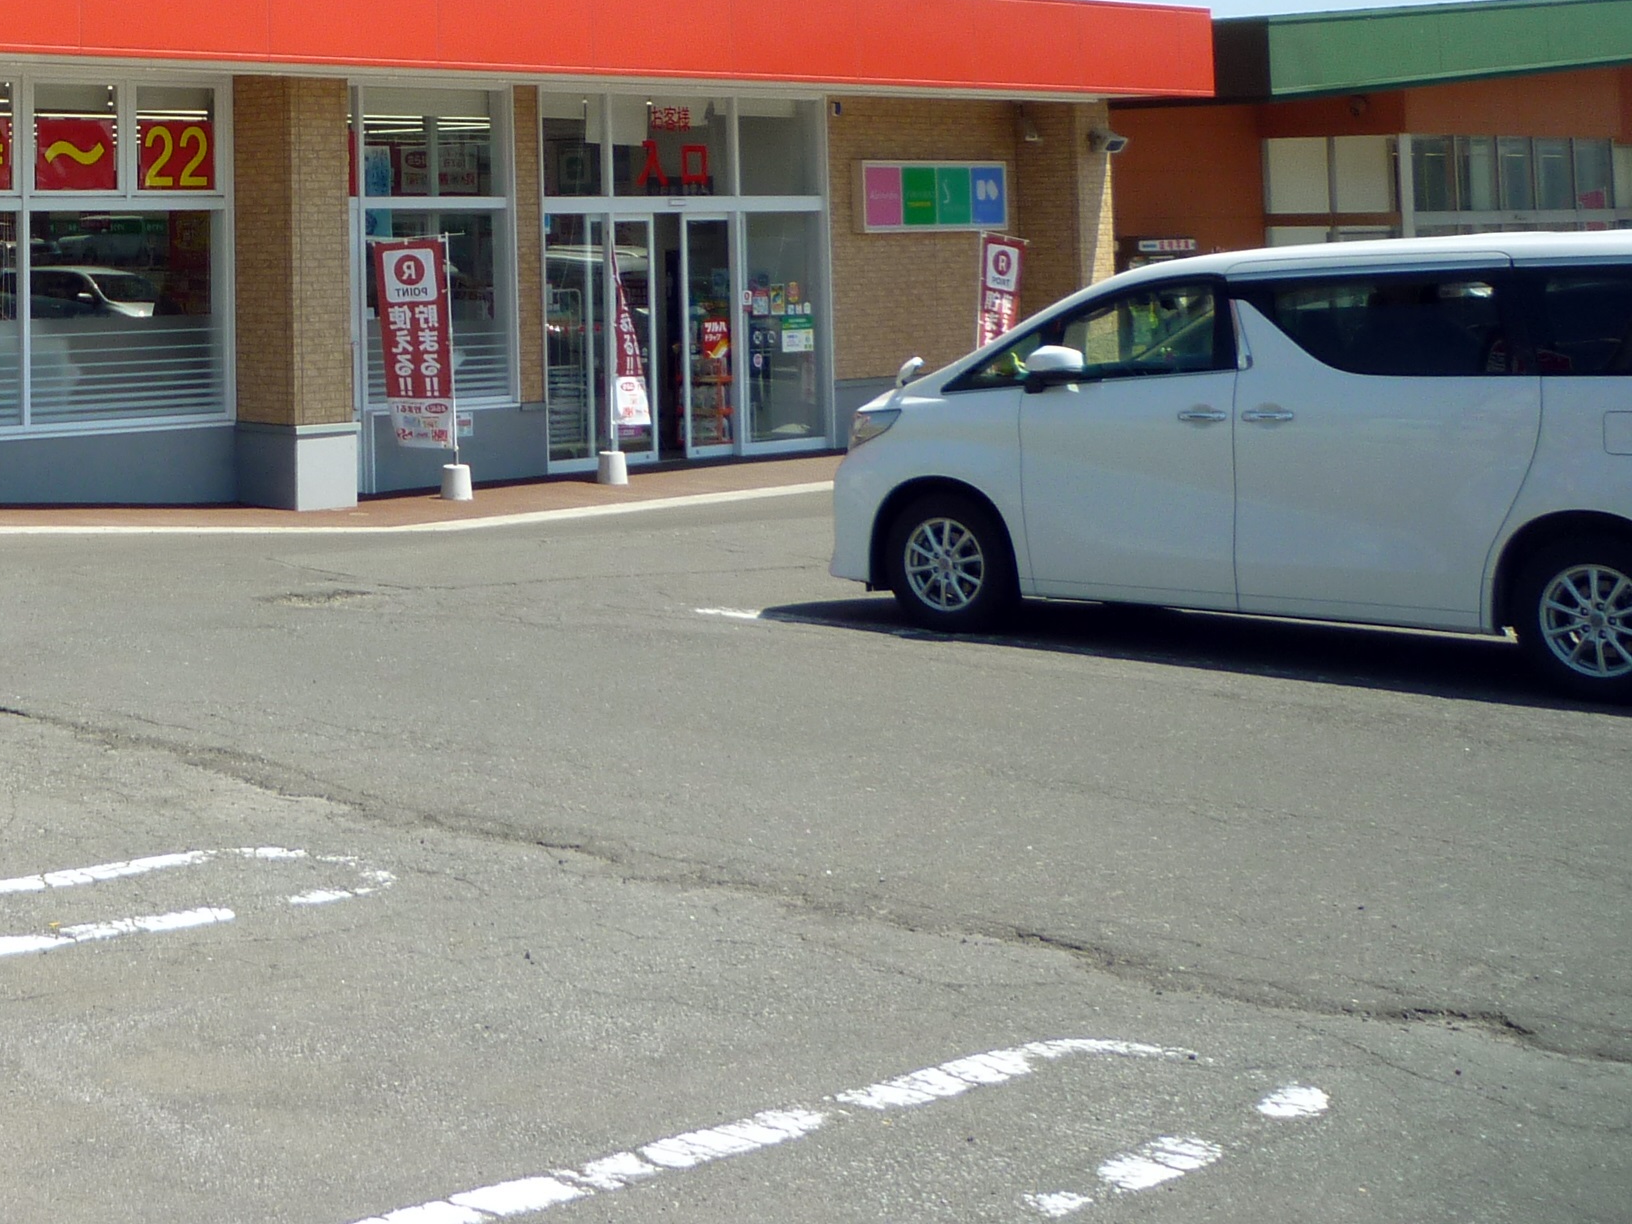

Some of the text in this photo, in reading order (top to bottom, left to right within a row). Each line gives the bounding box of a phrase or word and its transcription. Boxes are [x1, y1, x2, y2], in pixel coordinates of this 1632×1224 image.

[651, 106, 690, 132] お客様
[143, 125, 208, 187] 22
[636, 140, 709, 187] 入口
[704, 321, 727, 332] ツルハ
